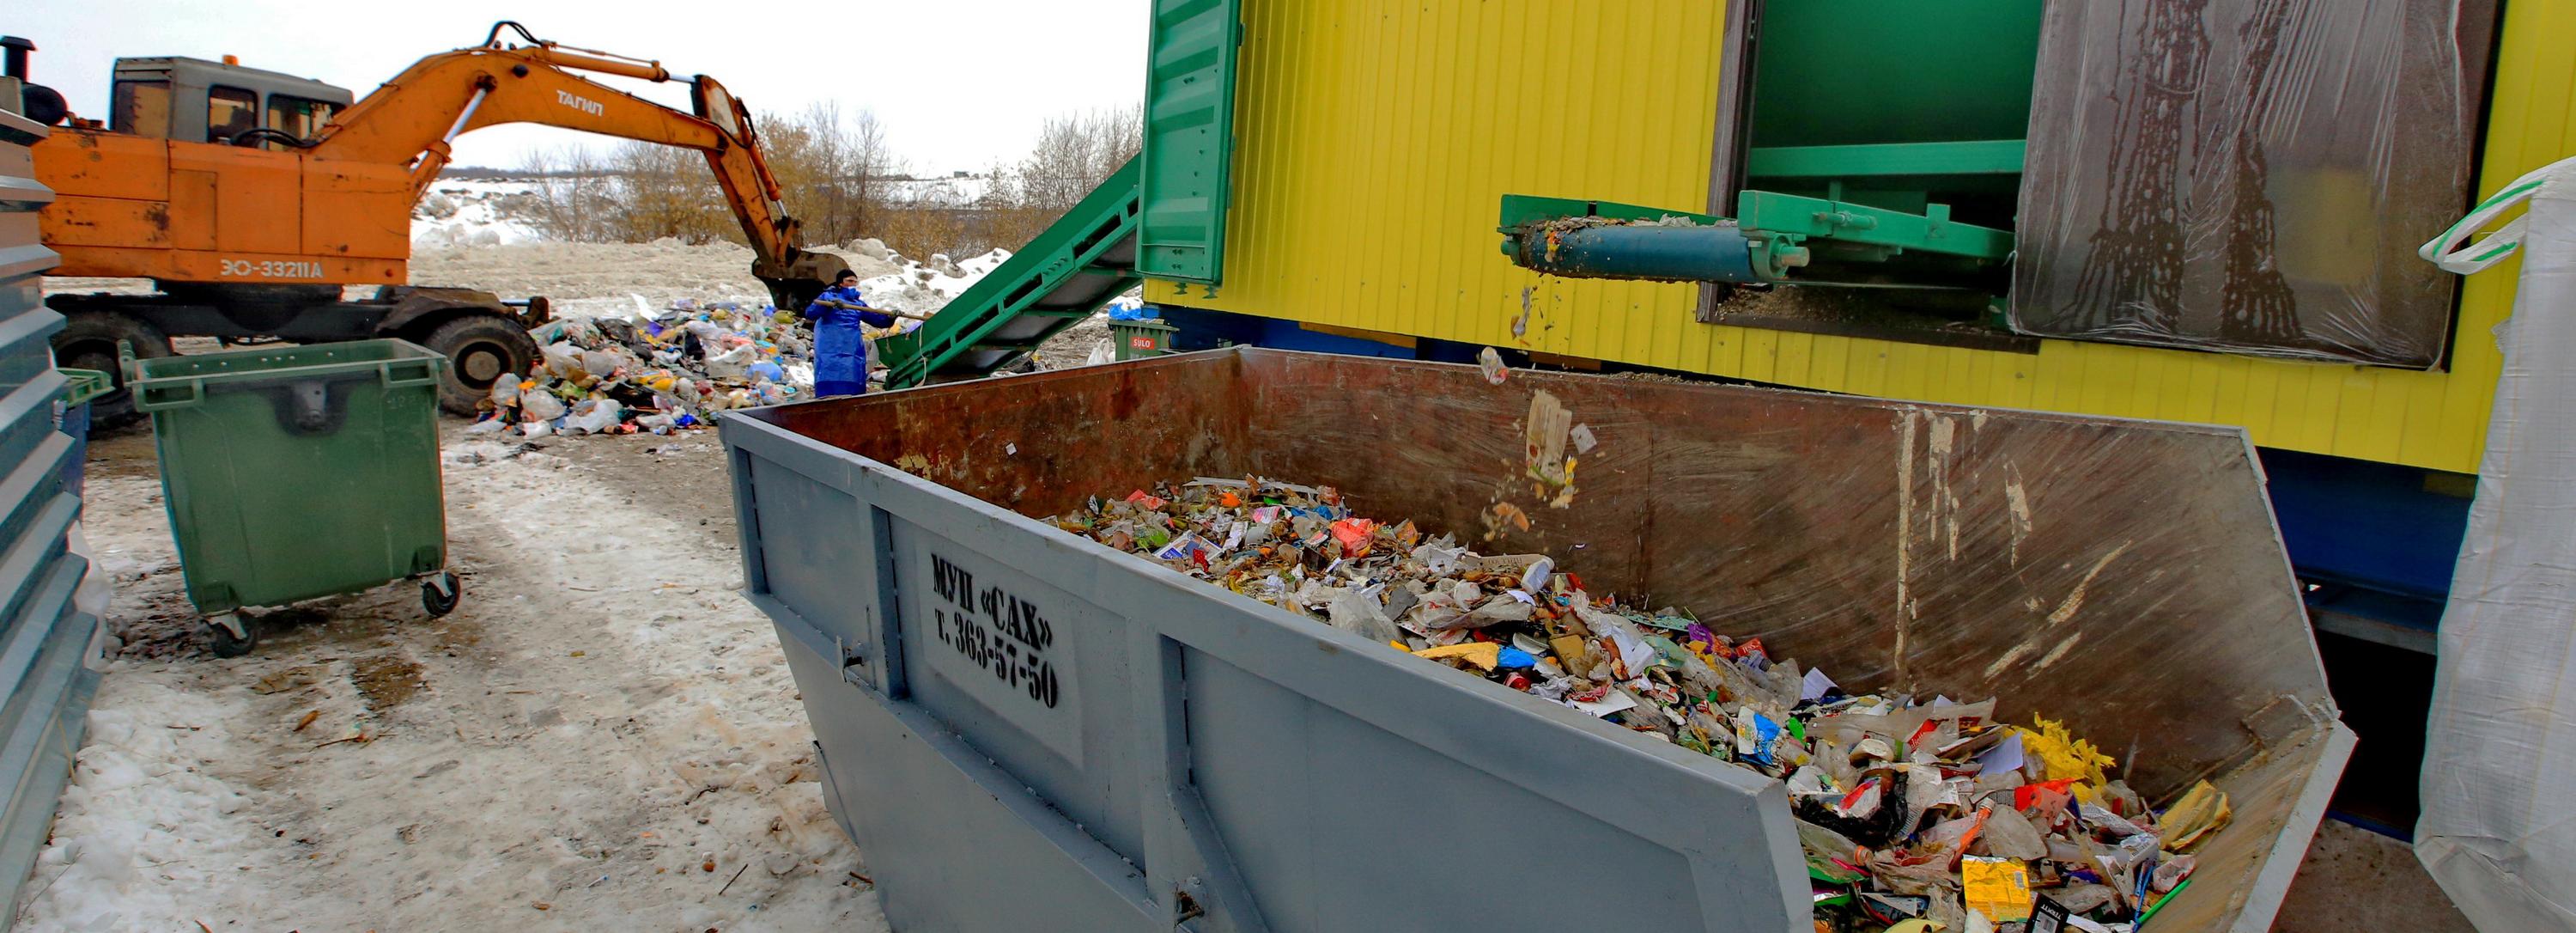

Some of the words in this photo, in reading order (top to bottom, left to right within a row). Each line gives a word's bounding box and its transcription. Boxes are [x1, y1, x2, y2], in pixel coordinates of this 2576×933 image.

[556, 89, 605, 117] ТАГИЛ
[220, 259, 324, 278] ЭО-33211А
[1133, 338, 1151, 347] SULO
[931, 552, 975, 613] МУП
[954, 611, 1058, 709] 363-57-50
